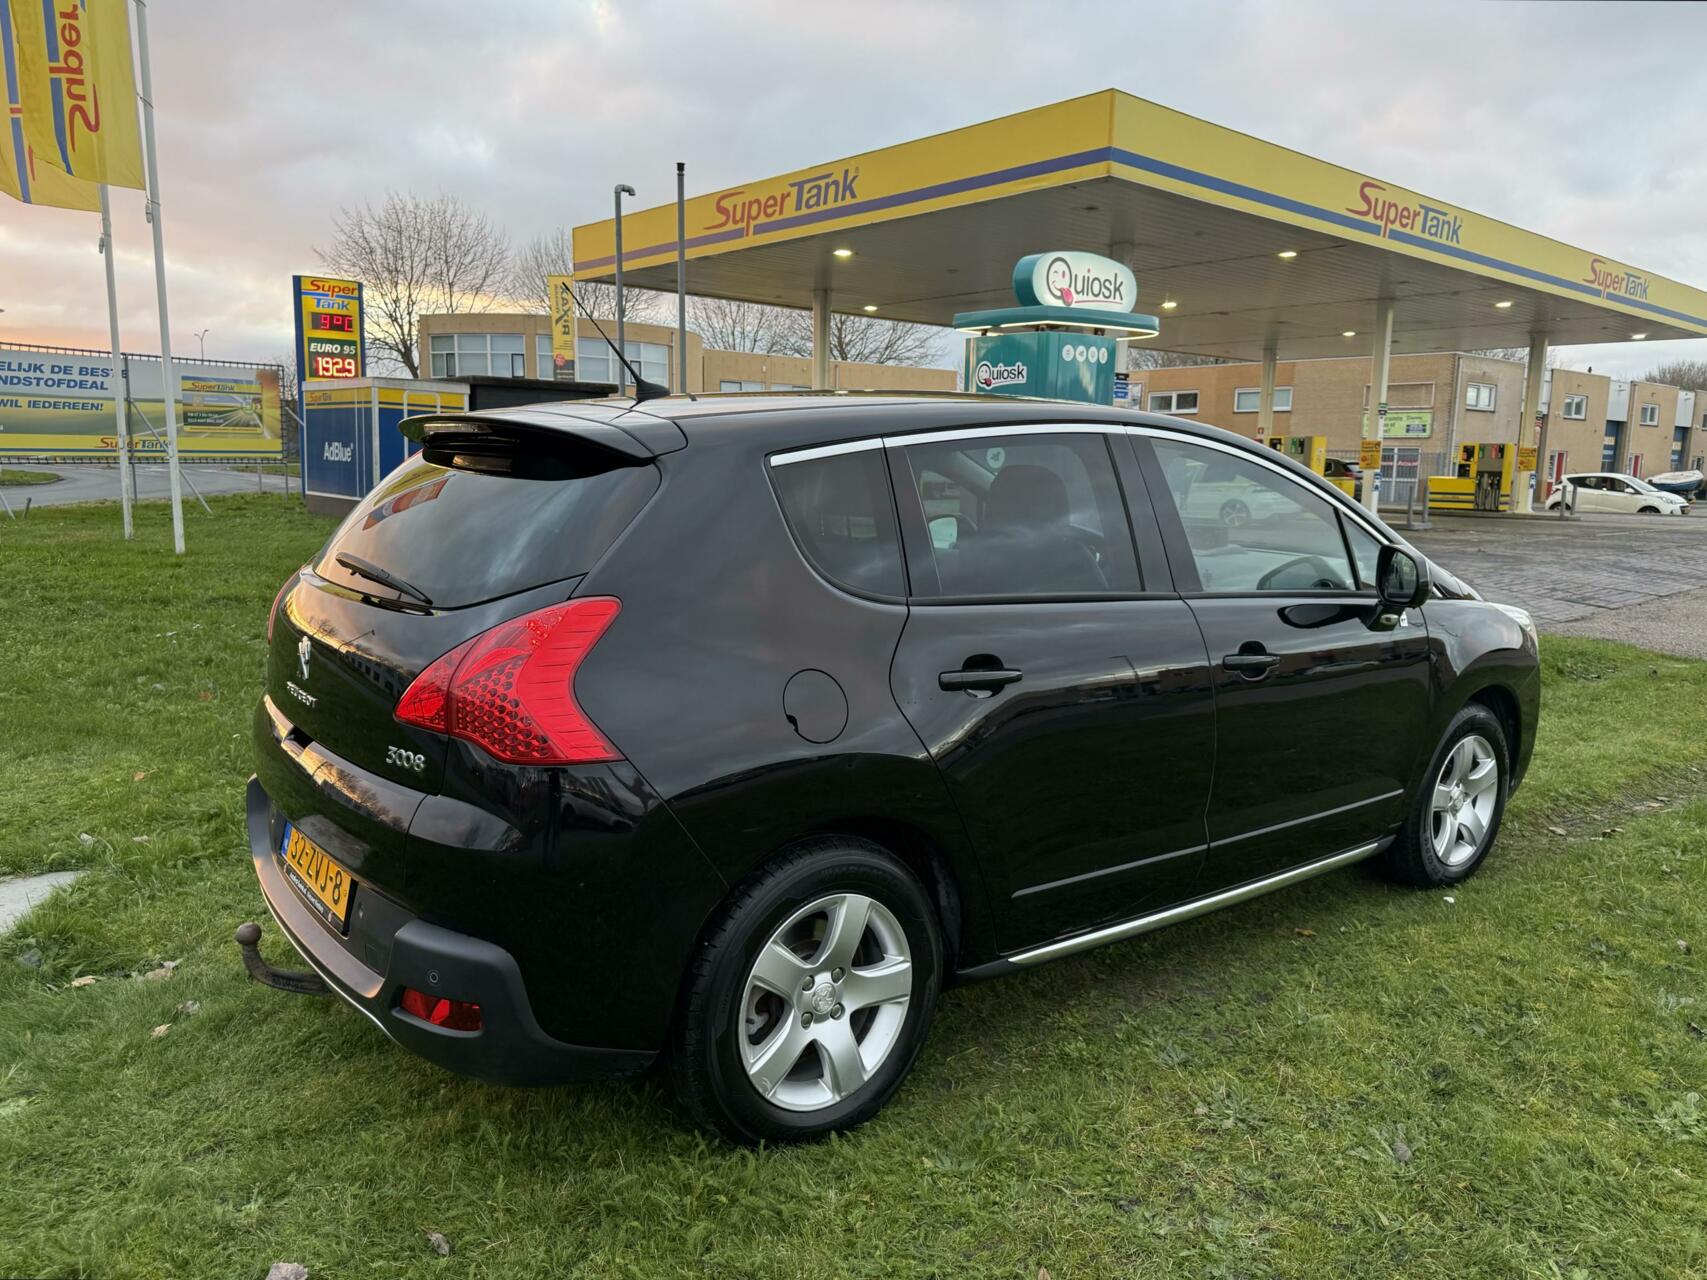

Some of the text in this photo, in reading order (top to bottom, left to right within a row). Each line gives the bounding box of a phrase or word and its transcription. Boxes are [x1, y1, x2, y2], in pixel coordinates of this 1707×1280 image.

[704, 168, 860, 237] SuperTank
[1345, 181, 1463, 245] SuperTank
[302, 279, 358, 298] Super
[1046, 256, 1124, 306] Quiosk
[1582, 258, 1649, 300] SuperTank
[311, 297, 350, 311] Tank
[309, 342, 356, 355] EURO 95
[51, 364, 74, 376] DE
[79, 366, 128, 379] BESE
[976, 361, 1025, 387] Quiosk
[28, 399, 103, 411] IEDEREEN!
[323, 441, 353, 462] AdBlue
[385, 745, 426, 771] 3008
[290, 832, 344, 905] 32-ZVJ-8
